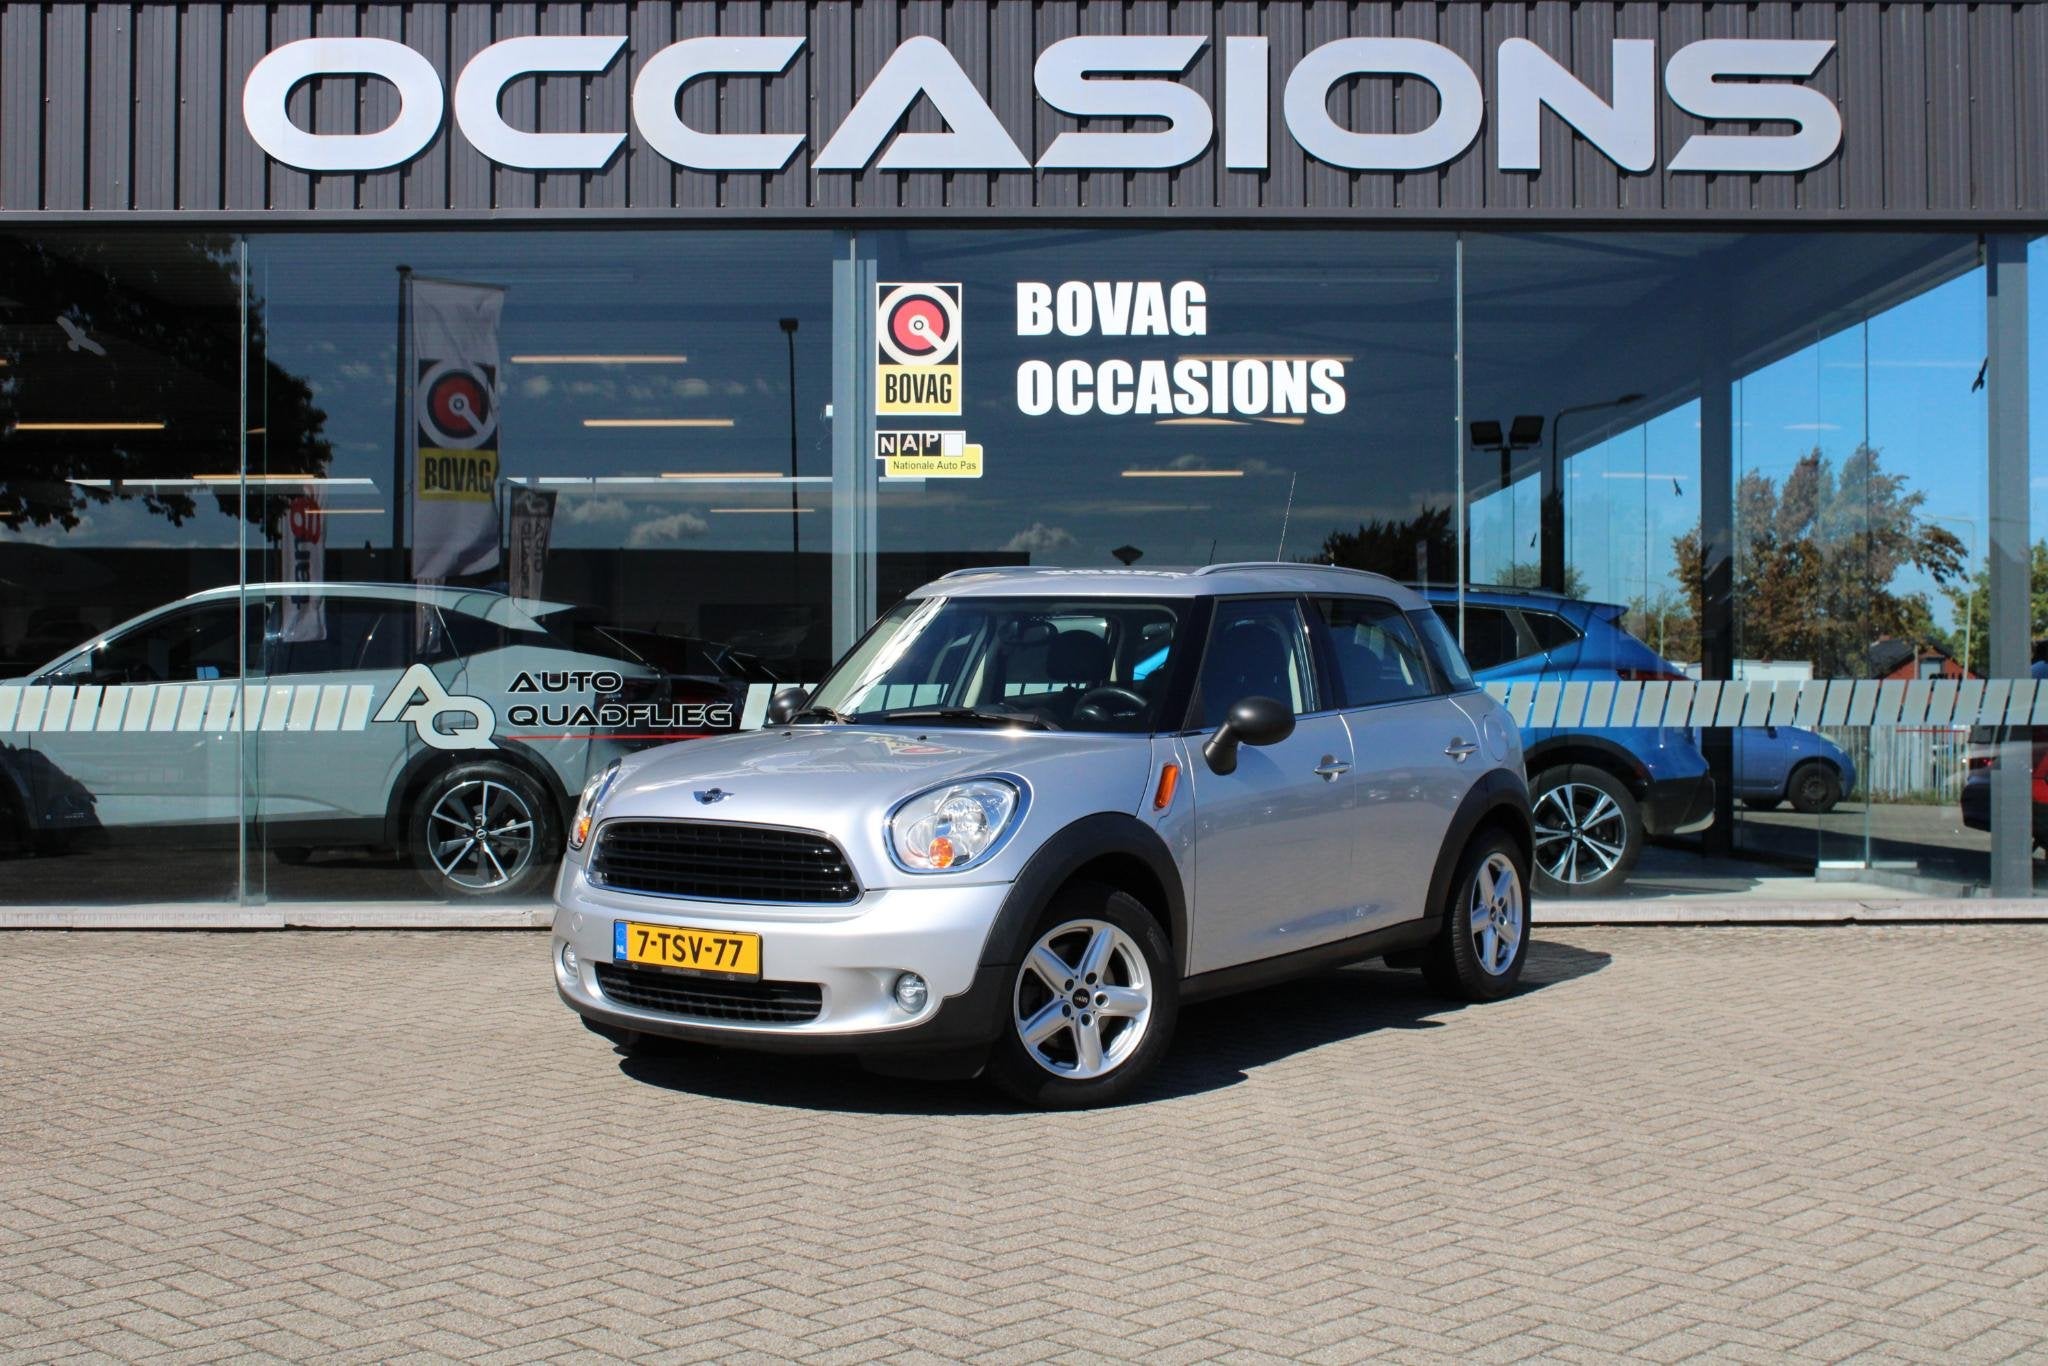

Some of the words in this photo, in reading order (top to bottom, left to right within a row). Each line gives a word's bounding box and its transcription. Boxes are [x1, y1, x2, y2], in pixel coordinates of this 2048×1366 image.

[243, 35, 1842, 172] OCCASIONS
[1017, 281, 1207, 336] BOVAG
[885, 373, 952, 404] BOVAG
[1016, 359, 1346, 416] OCCASIONS
[880, 433, 939, 454] NAP
[424, 457, 491, 493] BOVAG
[893, 460, 934, 470] Nationale
[937, 460, 957, 470] Auto
[960, 460, 976, 470] Pas
[506, 671, 623, 694] AUTO
[372, 663, 499, 749] AQ
[506, 703, 733, 728] QUADFLIEG
[637, 930, 743, 967] 7-TSV-77
